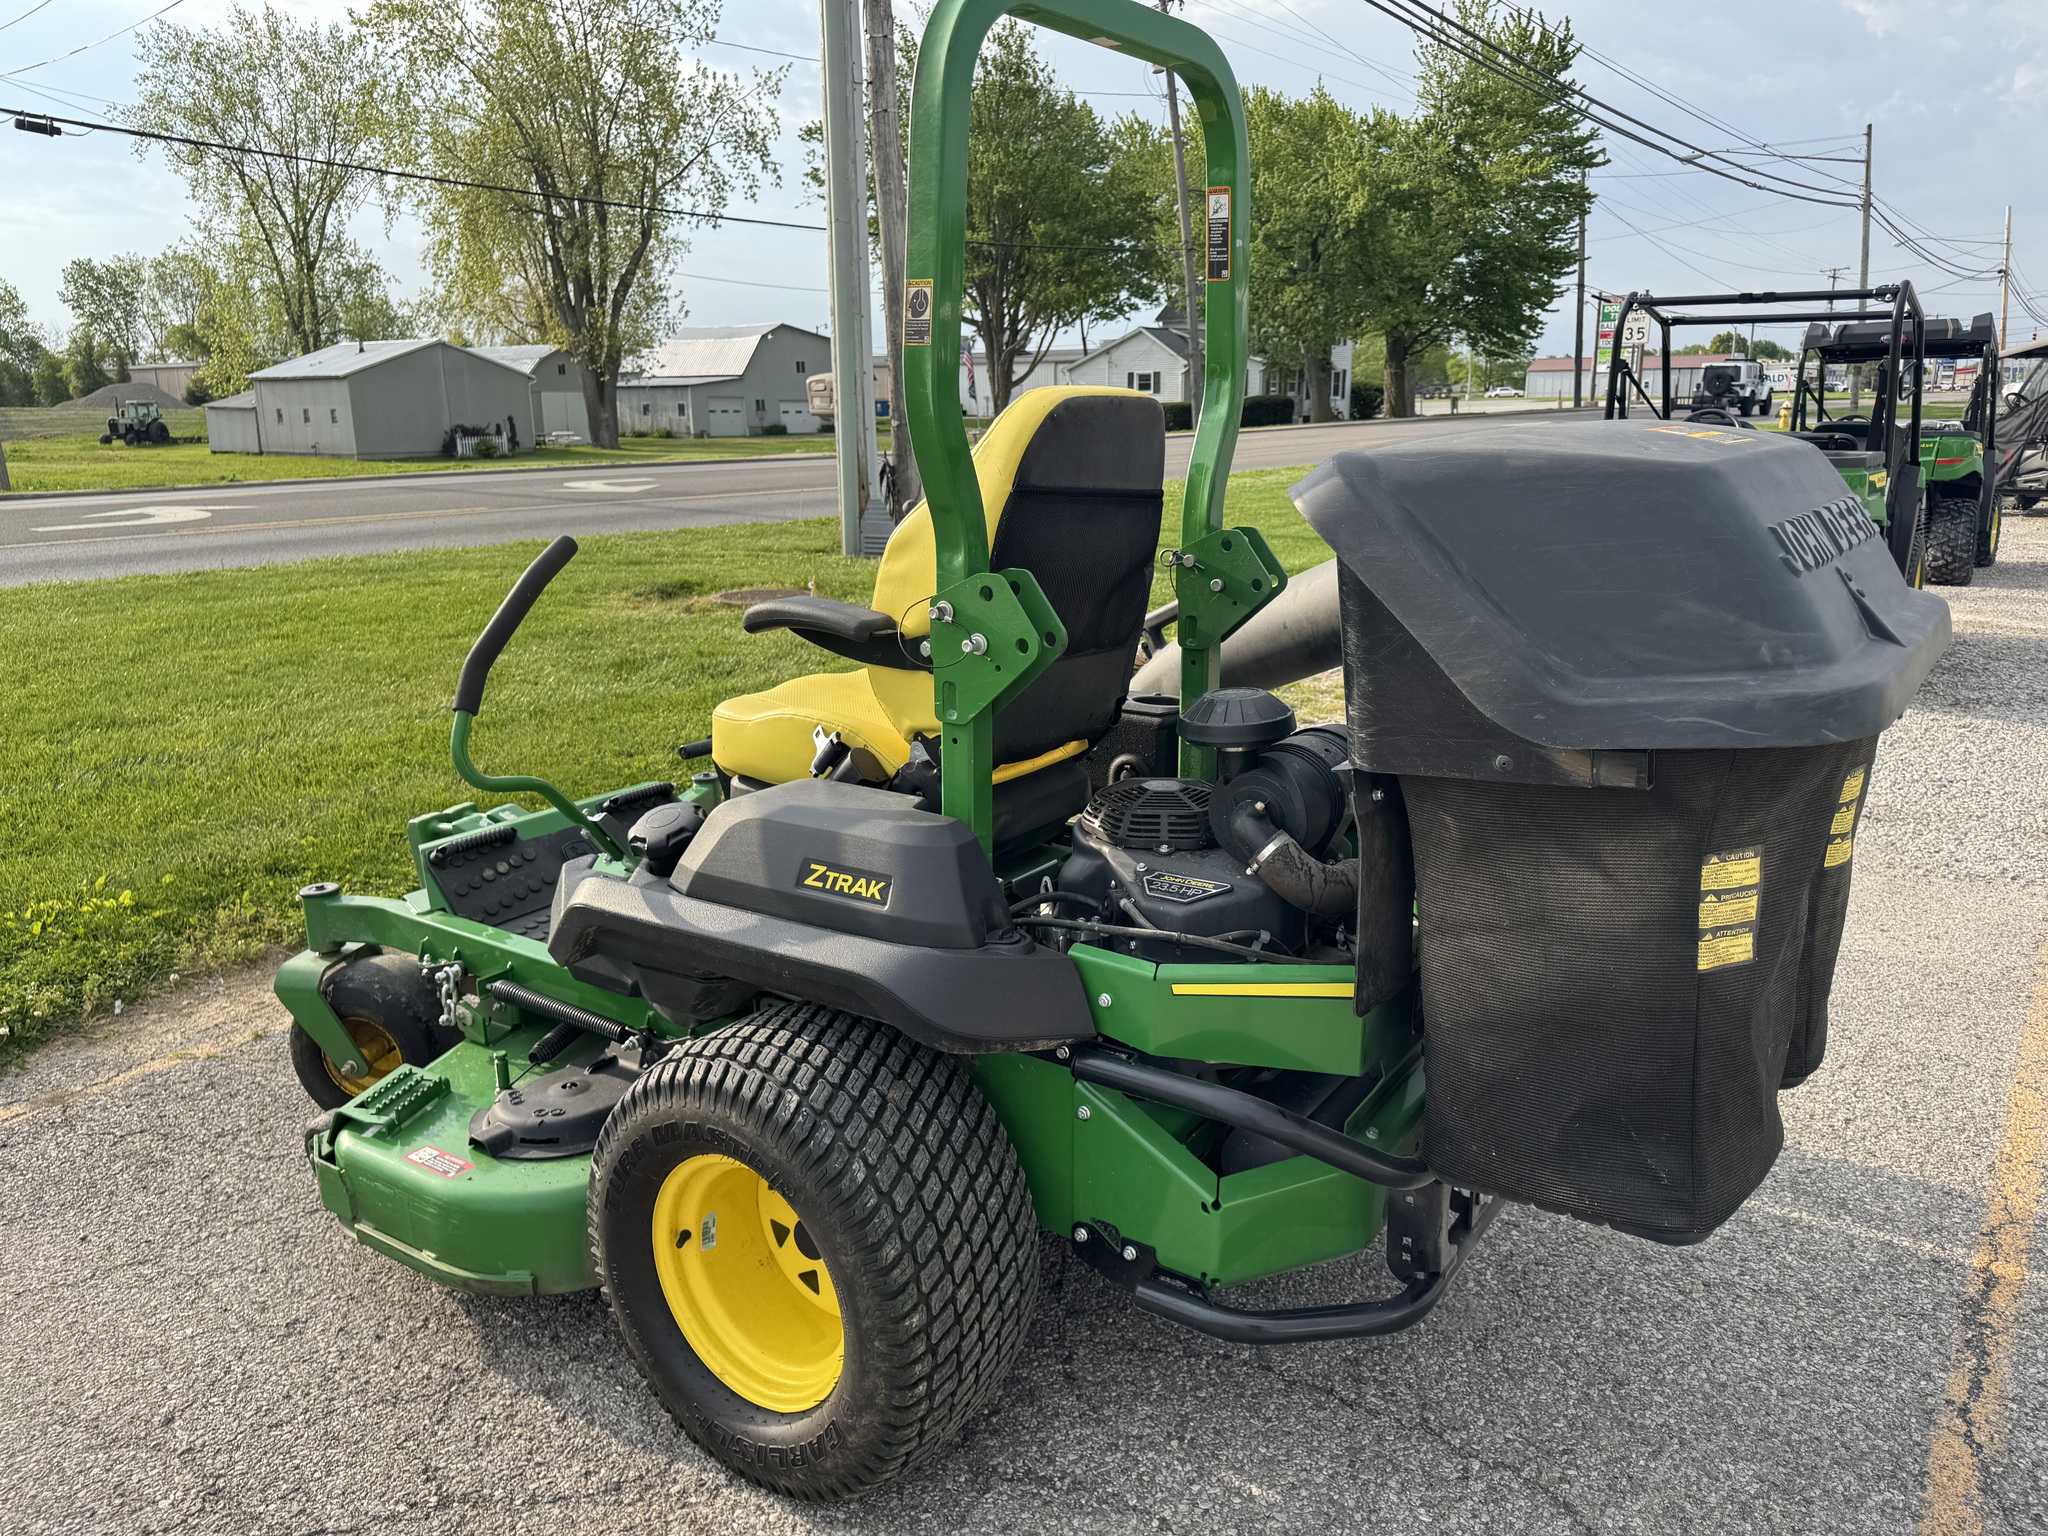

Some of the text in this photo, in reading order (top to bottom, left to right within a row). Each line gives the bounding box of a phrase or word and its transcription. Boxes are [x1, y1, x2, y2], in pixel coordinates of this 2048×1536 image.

[1625, 327, 1645, 340] 35
[1767, 512, 1836, 576] JOHN
[1726, 851, 1755, 861] CAUTION
[804, 863, 886, 900] ZTRAK
[1150, 881, 1203, 896] 23.5 HP
[1160, 875, 1215, 888] JOHN DEERE
[1716, 927, 1750, 938] ATTENTION
[651, 1120, 795, 1200] MASTER
[685, 1402, 845, 1470] CARLISLE
